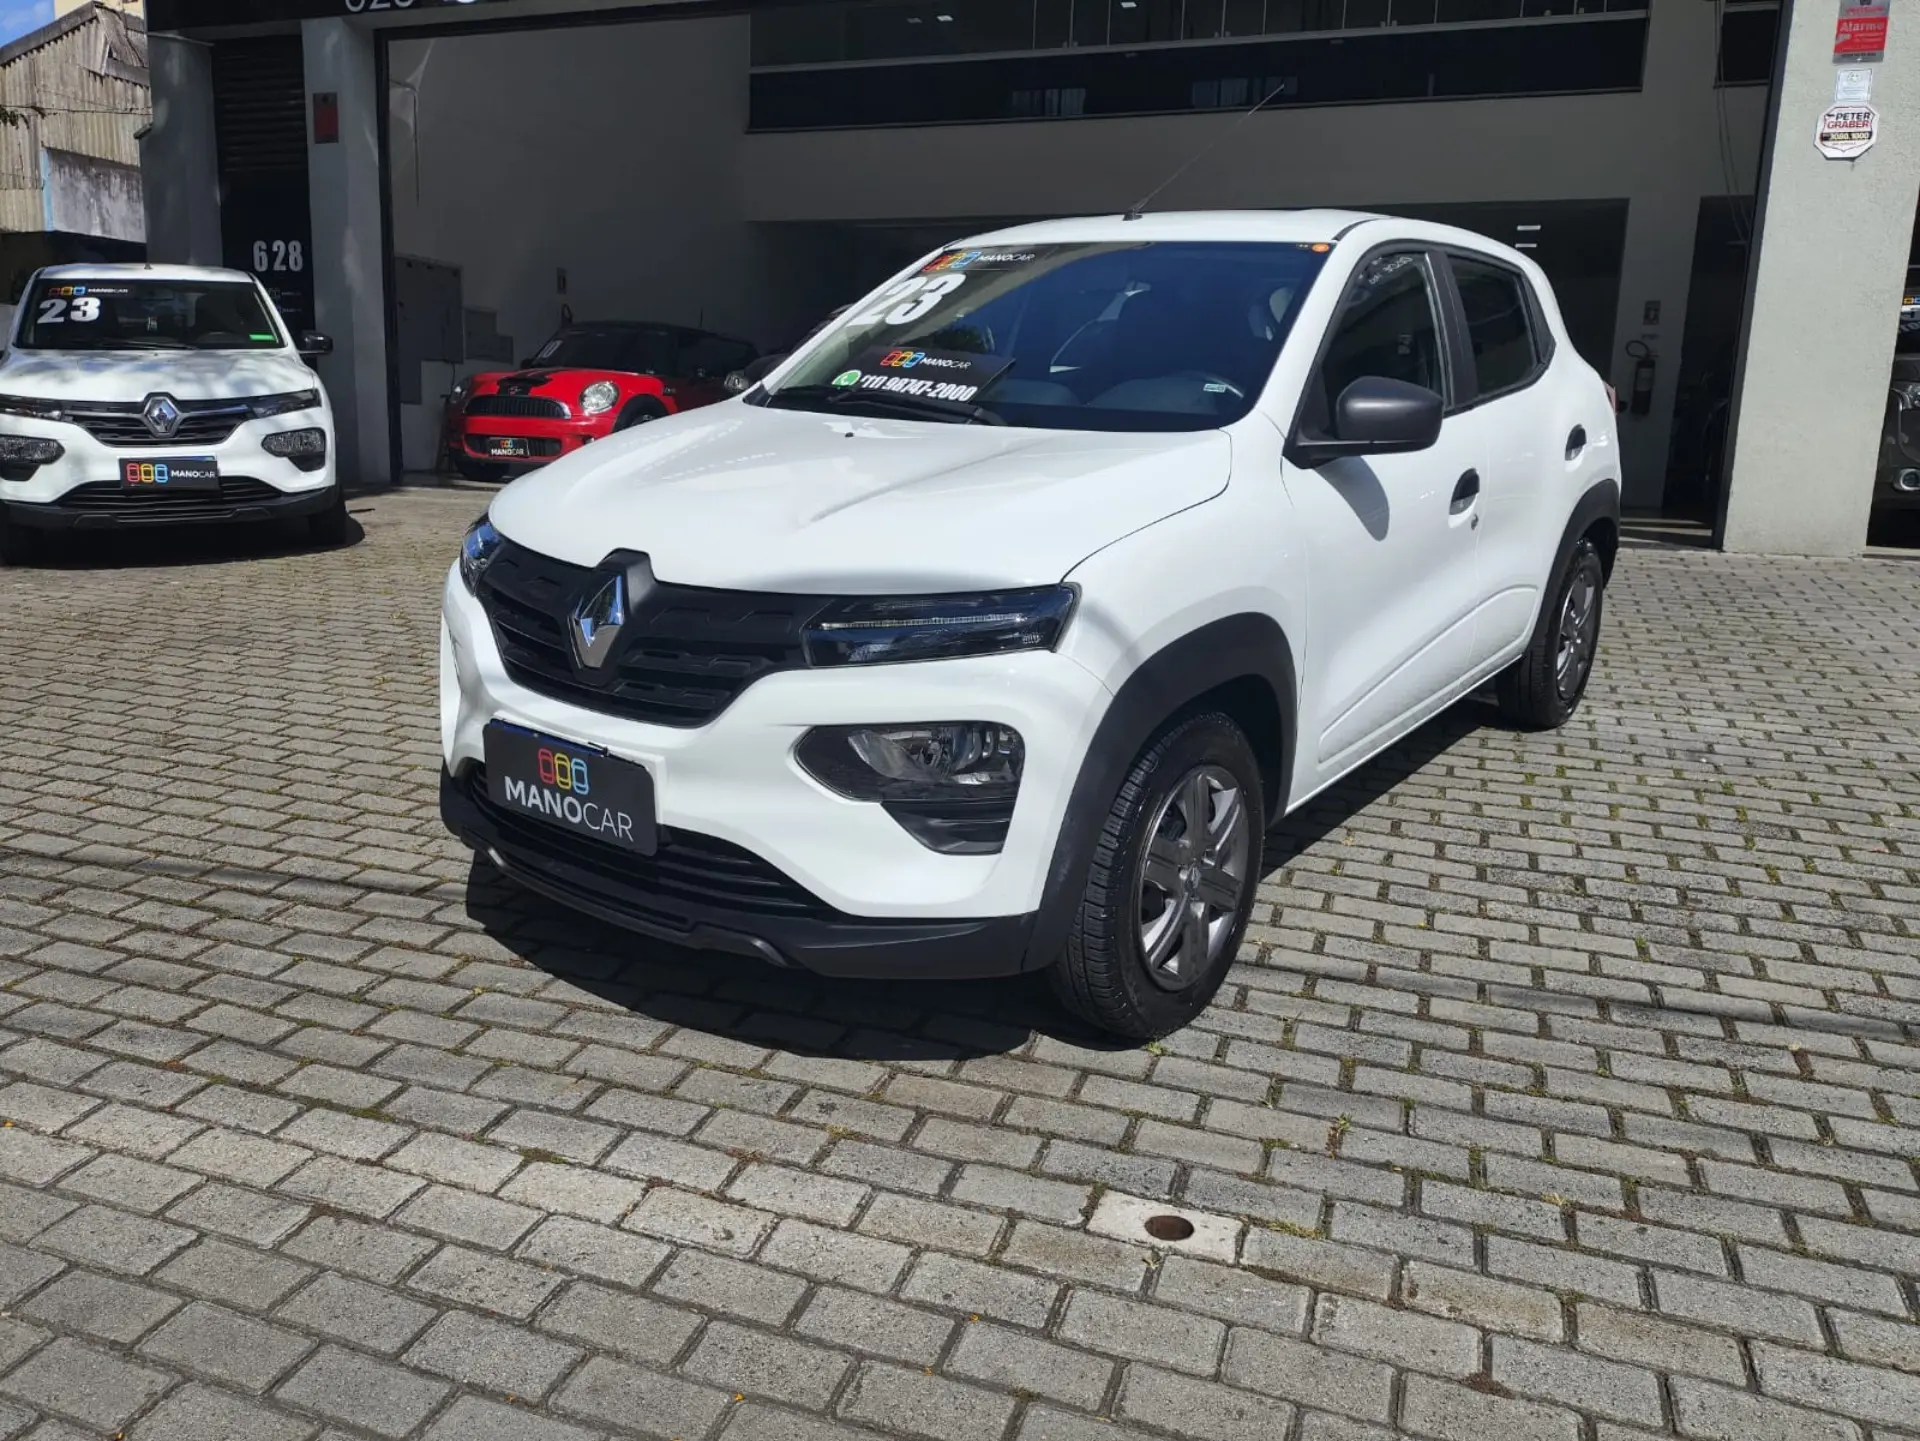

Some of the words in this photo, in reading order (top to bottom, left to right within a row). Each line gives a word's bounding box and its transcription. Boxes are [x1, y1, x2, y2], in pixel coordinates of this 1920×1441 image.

[1835, 112, 1871, 120] PETER
[1827, 120, 1869, 129] GRABER
[253, 240, 303, 272] 628
[977, 254, 1036, 262] MANOCAR
[847, 272, 967, 326] 23
[37, 296, 101, 324] 23
[920, 357, 972, 369] MANOCAR
[882, 376, 978, 402] 98747-2000
[491, 448, 524, 456] MANOCAR
[171, 469, 215, 478] MANOCAR
[504, 776, 634, 842] MANOCAR
